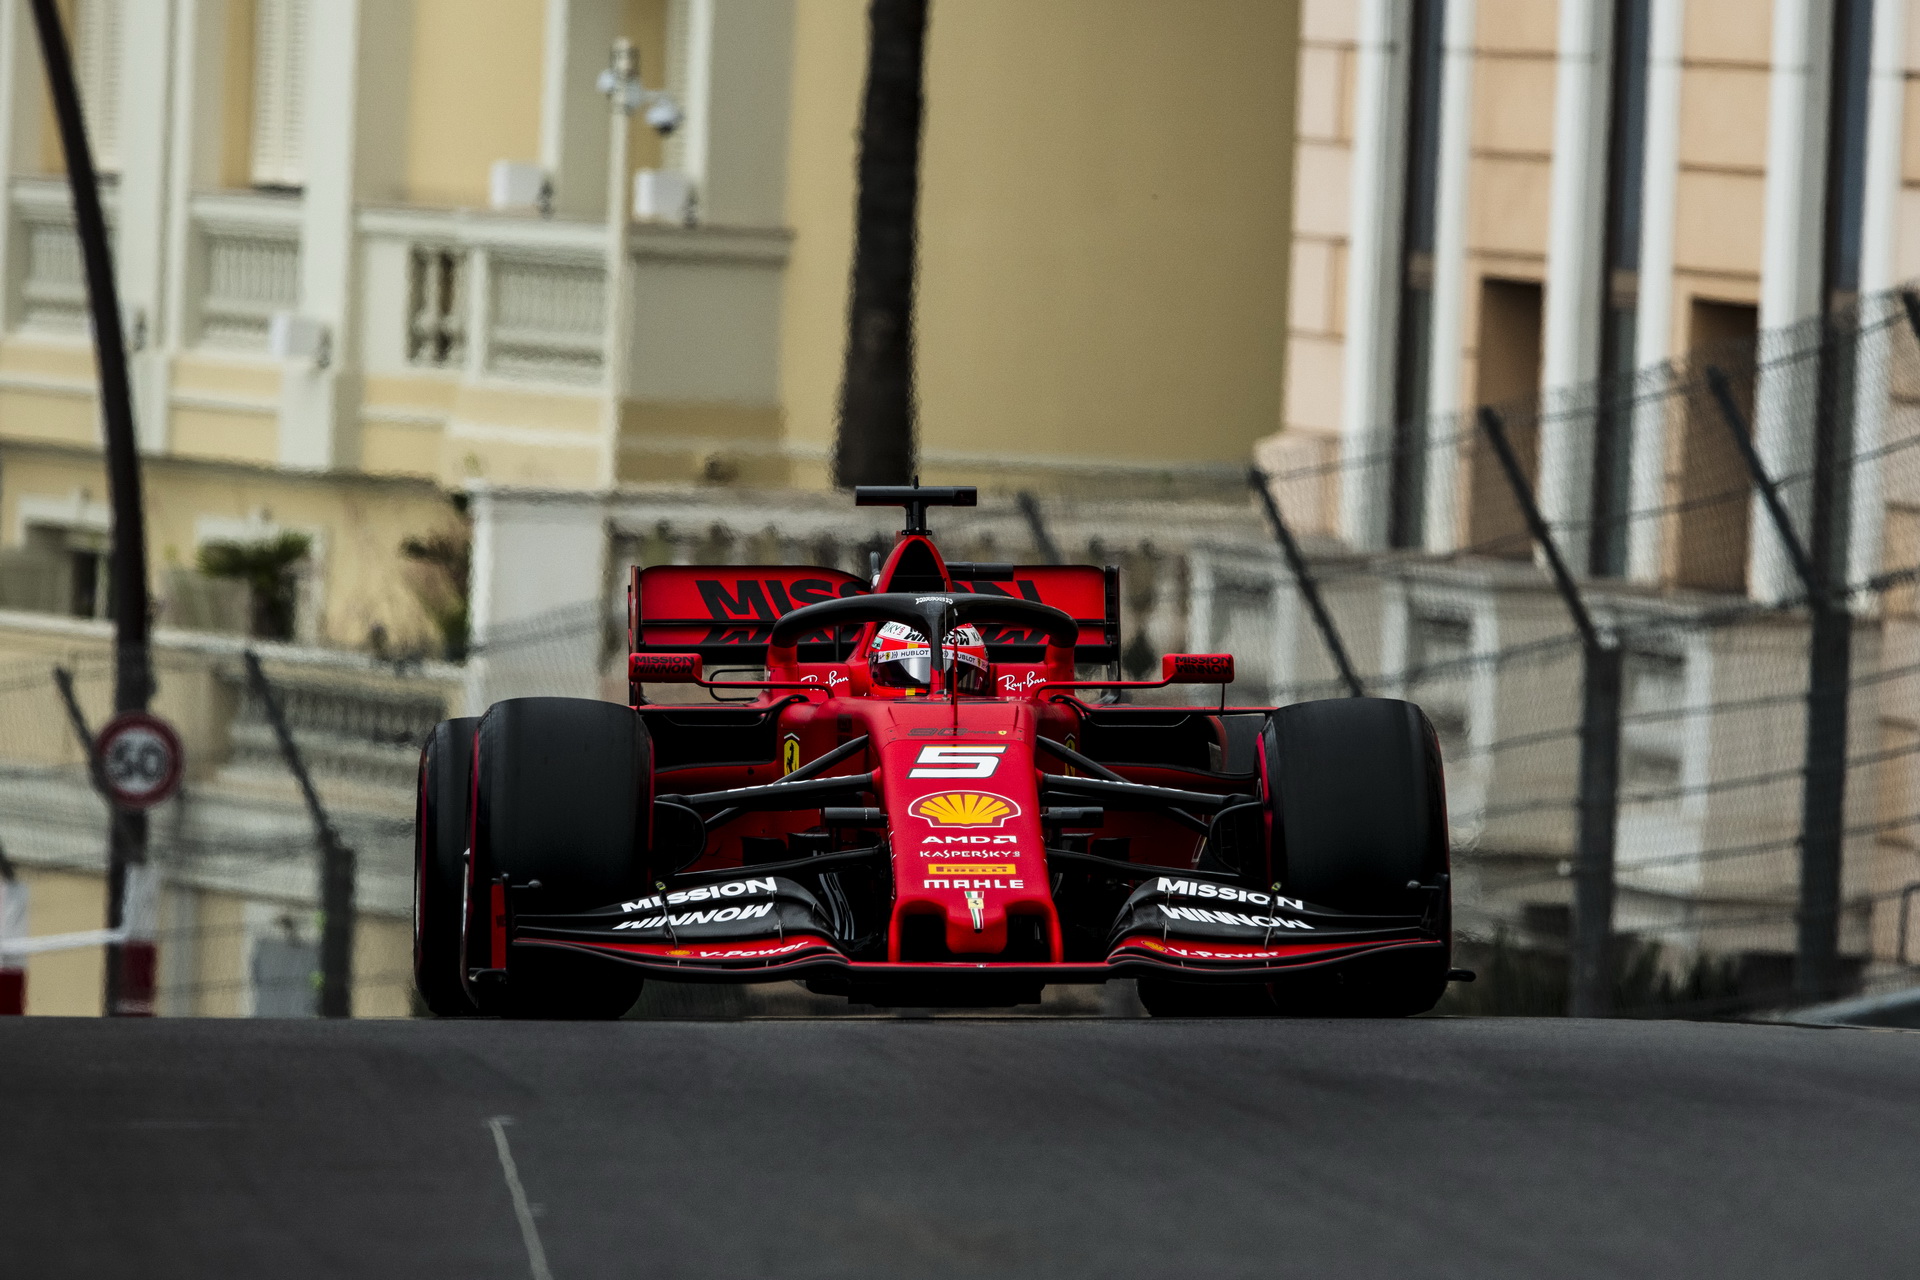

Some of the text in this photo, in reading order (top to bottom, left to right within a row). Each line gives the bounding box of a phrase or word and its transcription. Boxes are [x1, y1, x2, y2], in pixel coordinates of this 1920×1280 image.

[900, 649, 930, 658] HUBLOT
[634, 656, 695, 664] MISSION
[1175, 656, 1231, 664] MISSION
[633, 664, 694, 674] WINNOW
[997, 671, 1047, 692] Ray-Ban
[906, 744, 1010, 779] 5
[921, 835, 991, 844] AMD
[919, 849, 1011, 859] KASPERSKY
[923, 879, 1024, 889] MAHLE
[621, 876, 777, 912] MISSION
[1156, 876, 1304, 910] MISSION
[612, 902, 774, 930] WINNOW
[1157, 903, 1315, 930] WINNOW
[700, 941, 809, 958] V-Power
[1167, 946, 1279, 958] V-Power
